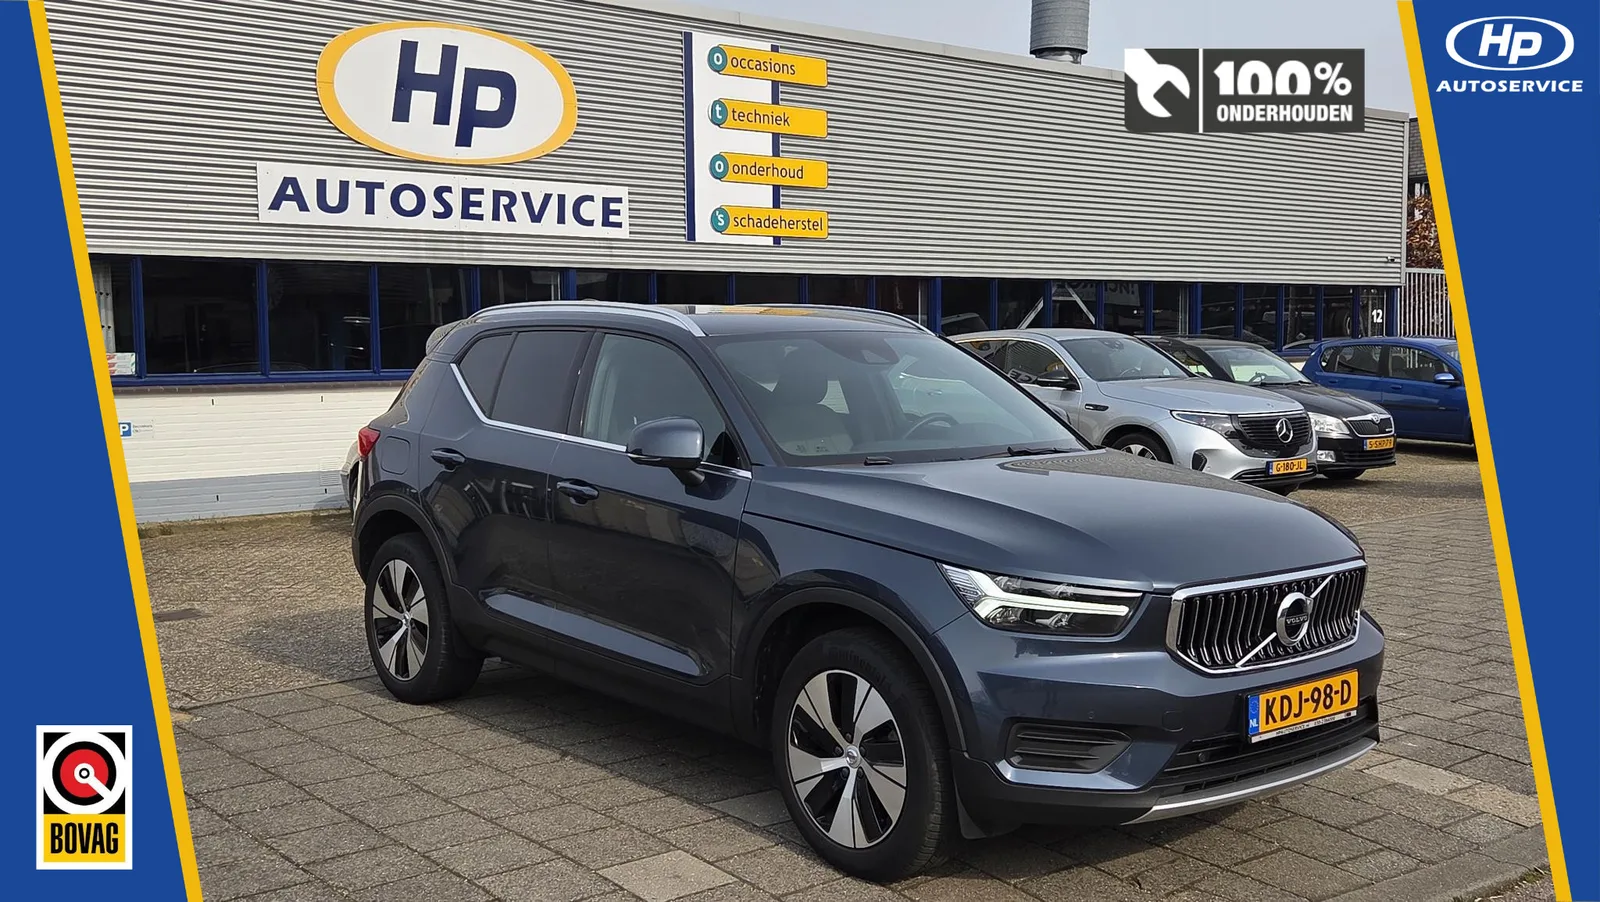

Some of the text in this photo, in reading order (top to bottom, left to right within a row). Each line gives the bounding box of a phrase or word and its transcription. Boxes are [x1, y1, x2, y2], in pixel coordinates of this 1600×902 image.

[730, 57, 796, 75] occasions
[732, 107, 790, 127] techniek
[732, 161, 804, 180] onderhoud
[267, 175, 624, 229] AUTOSERVICE
[733, 213, 824, 232] schadeherstel
[1371, 309, 1383, 323] 12
[1276, 460, 1303, 472] G-180-JL
[1286, 615, 1308, 624] VOLVO
[1265, 679, 1352, 726] KDJ-98-D
[1249, 718, 1259, 729] NL
